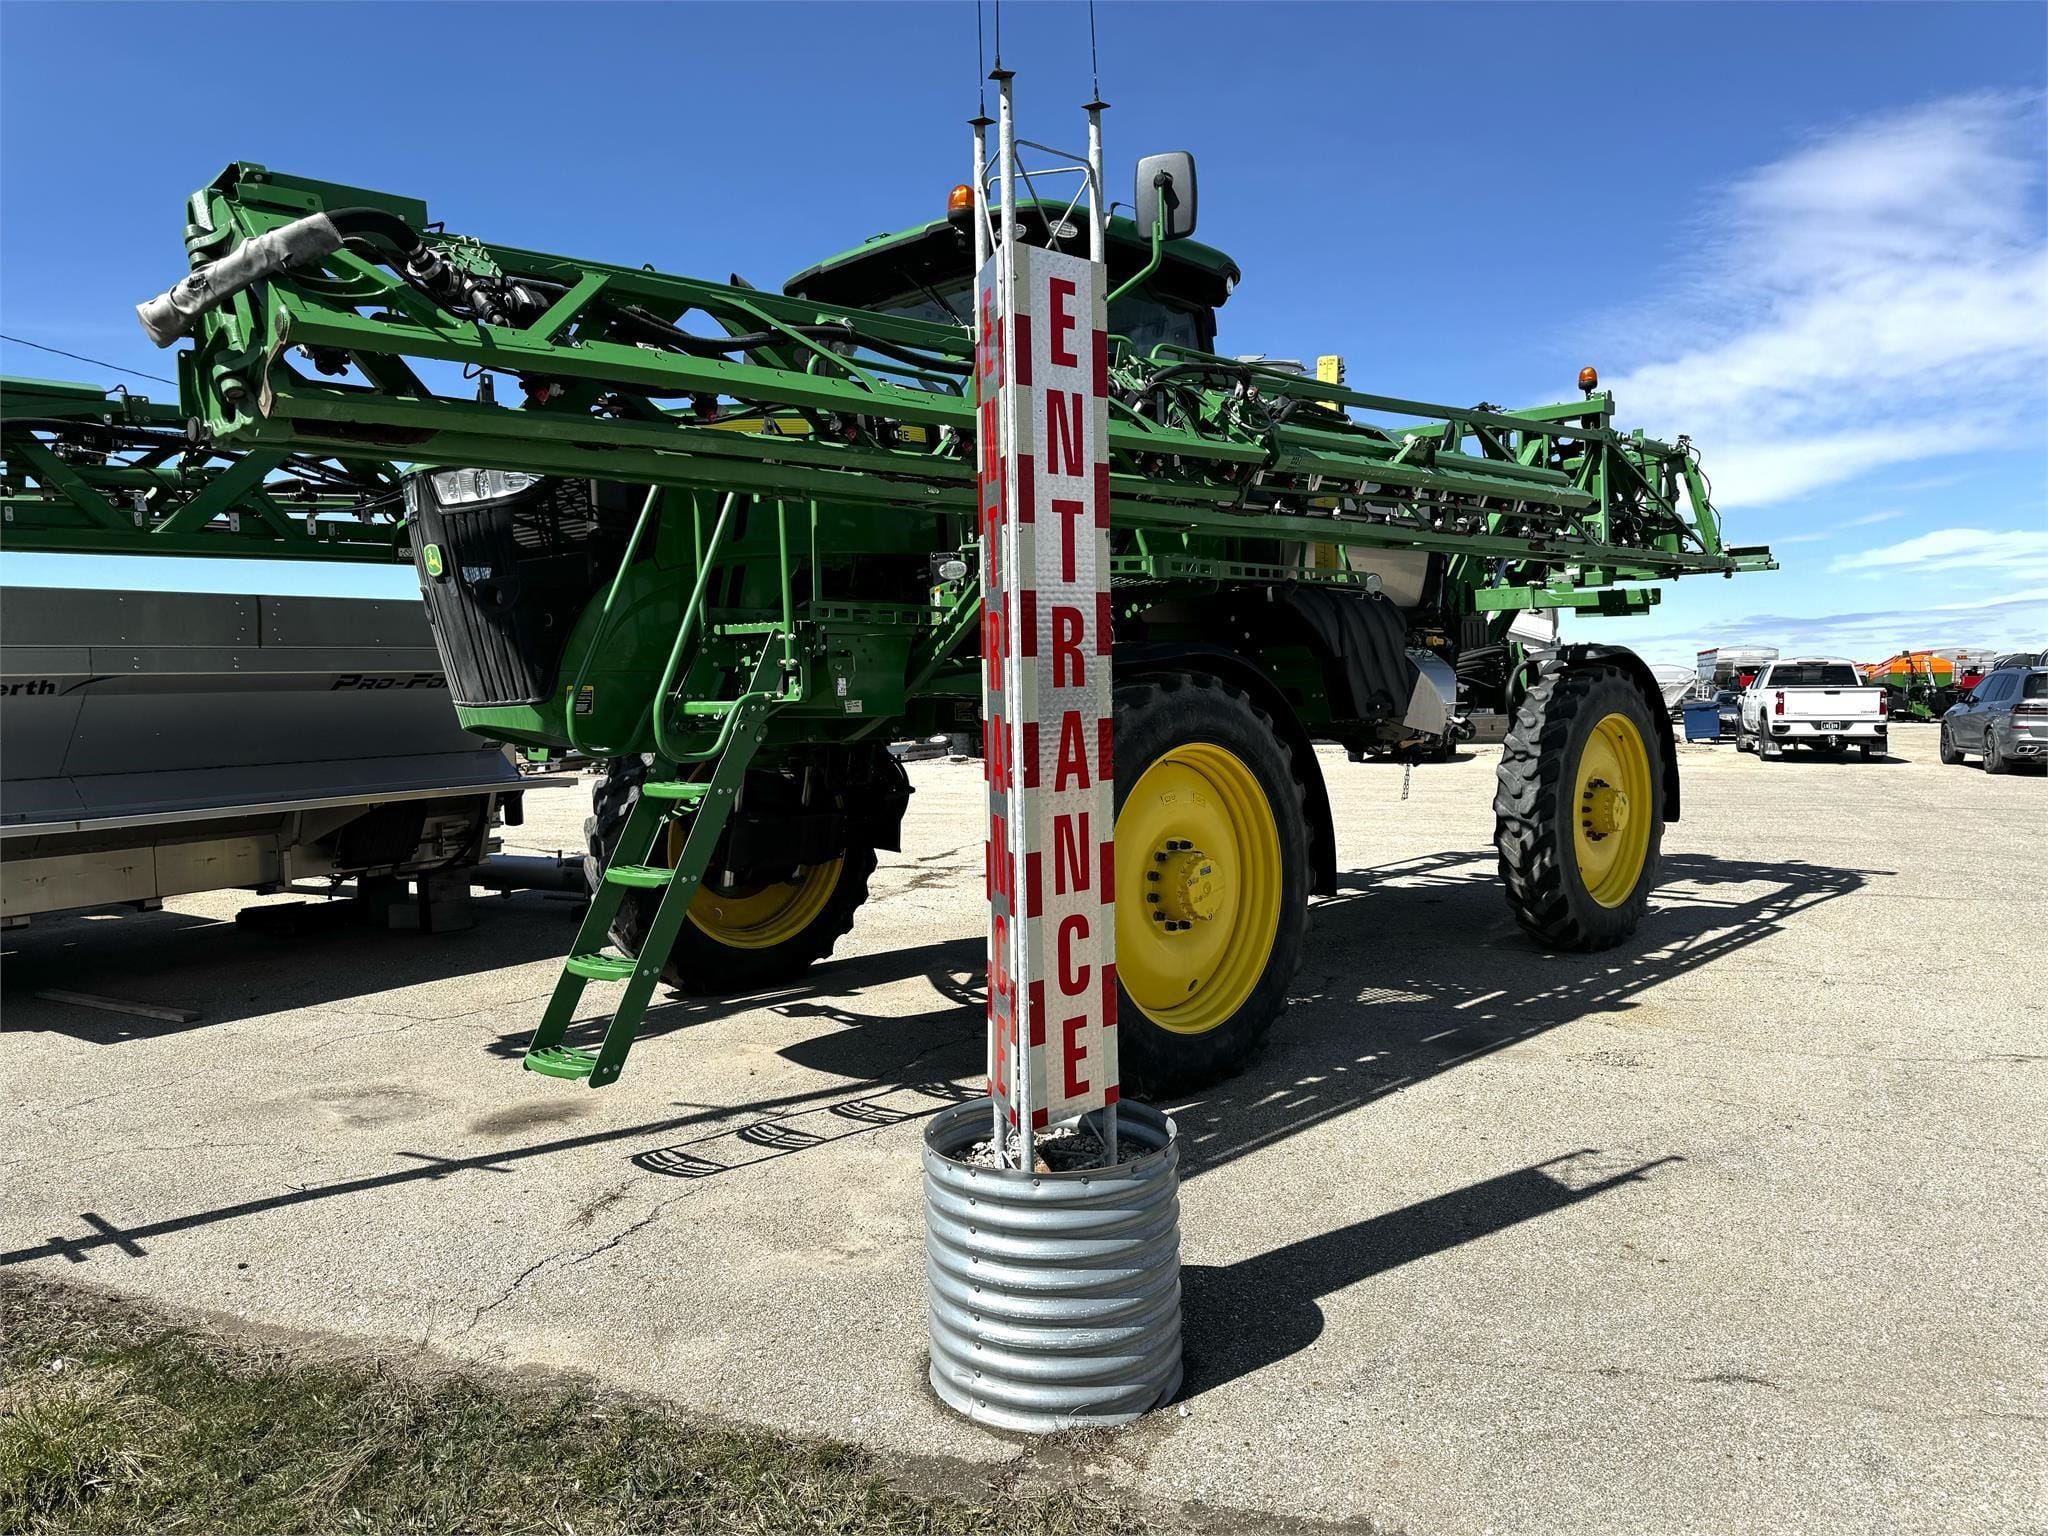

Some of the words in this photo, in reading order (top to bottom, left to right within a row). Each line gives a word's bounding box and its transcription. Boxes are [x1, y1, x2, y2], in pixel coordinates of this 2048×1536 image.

[0, 680, 56, 696] erth
[330, 674, 448, 691] PRO-FO
[983, 287, 1007, 1097] ENTRANCE
[1046, 276, 1091, 1099] ENTRANCE
